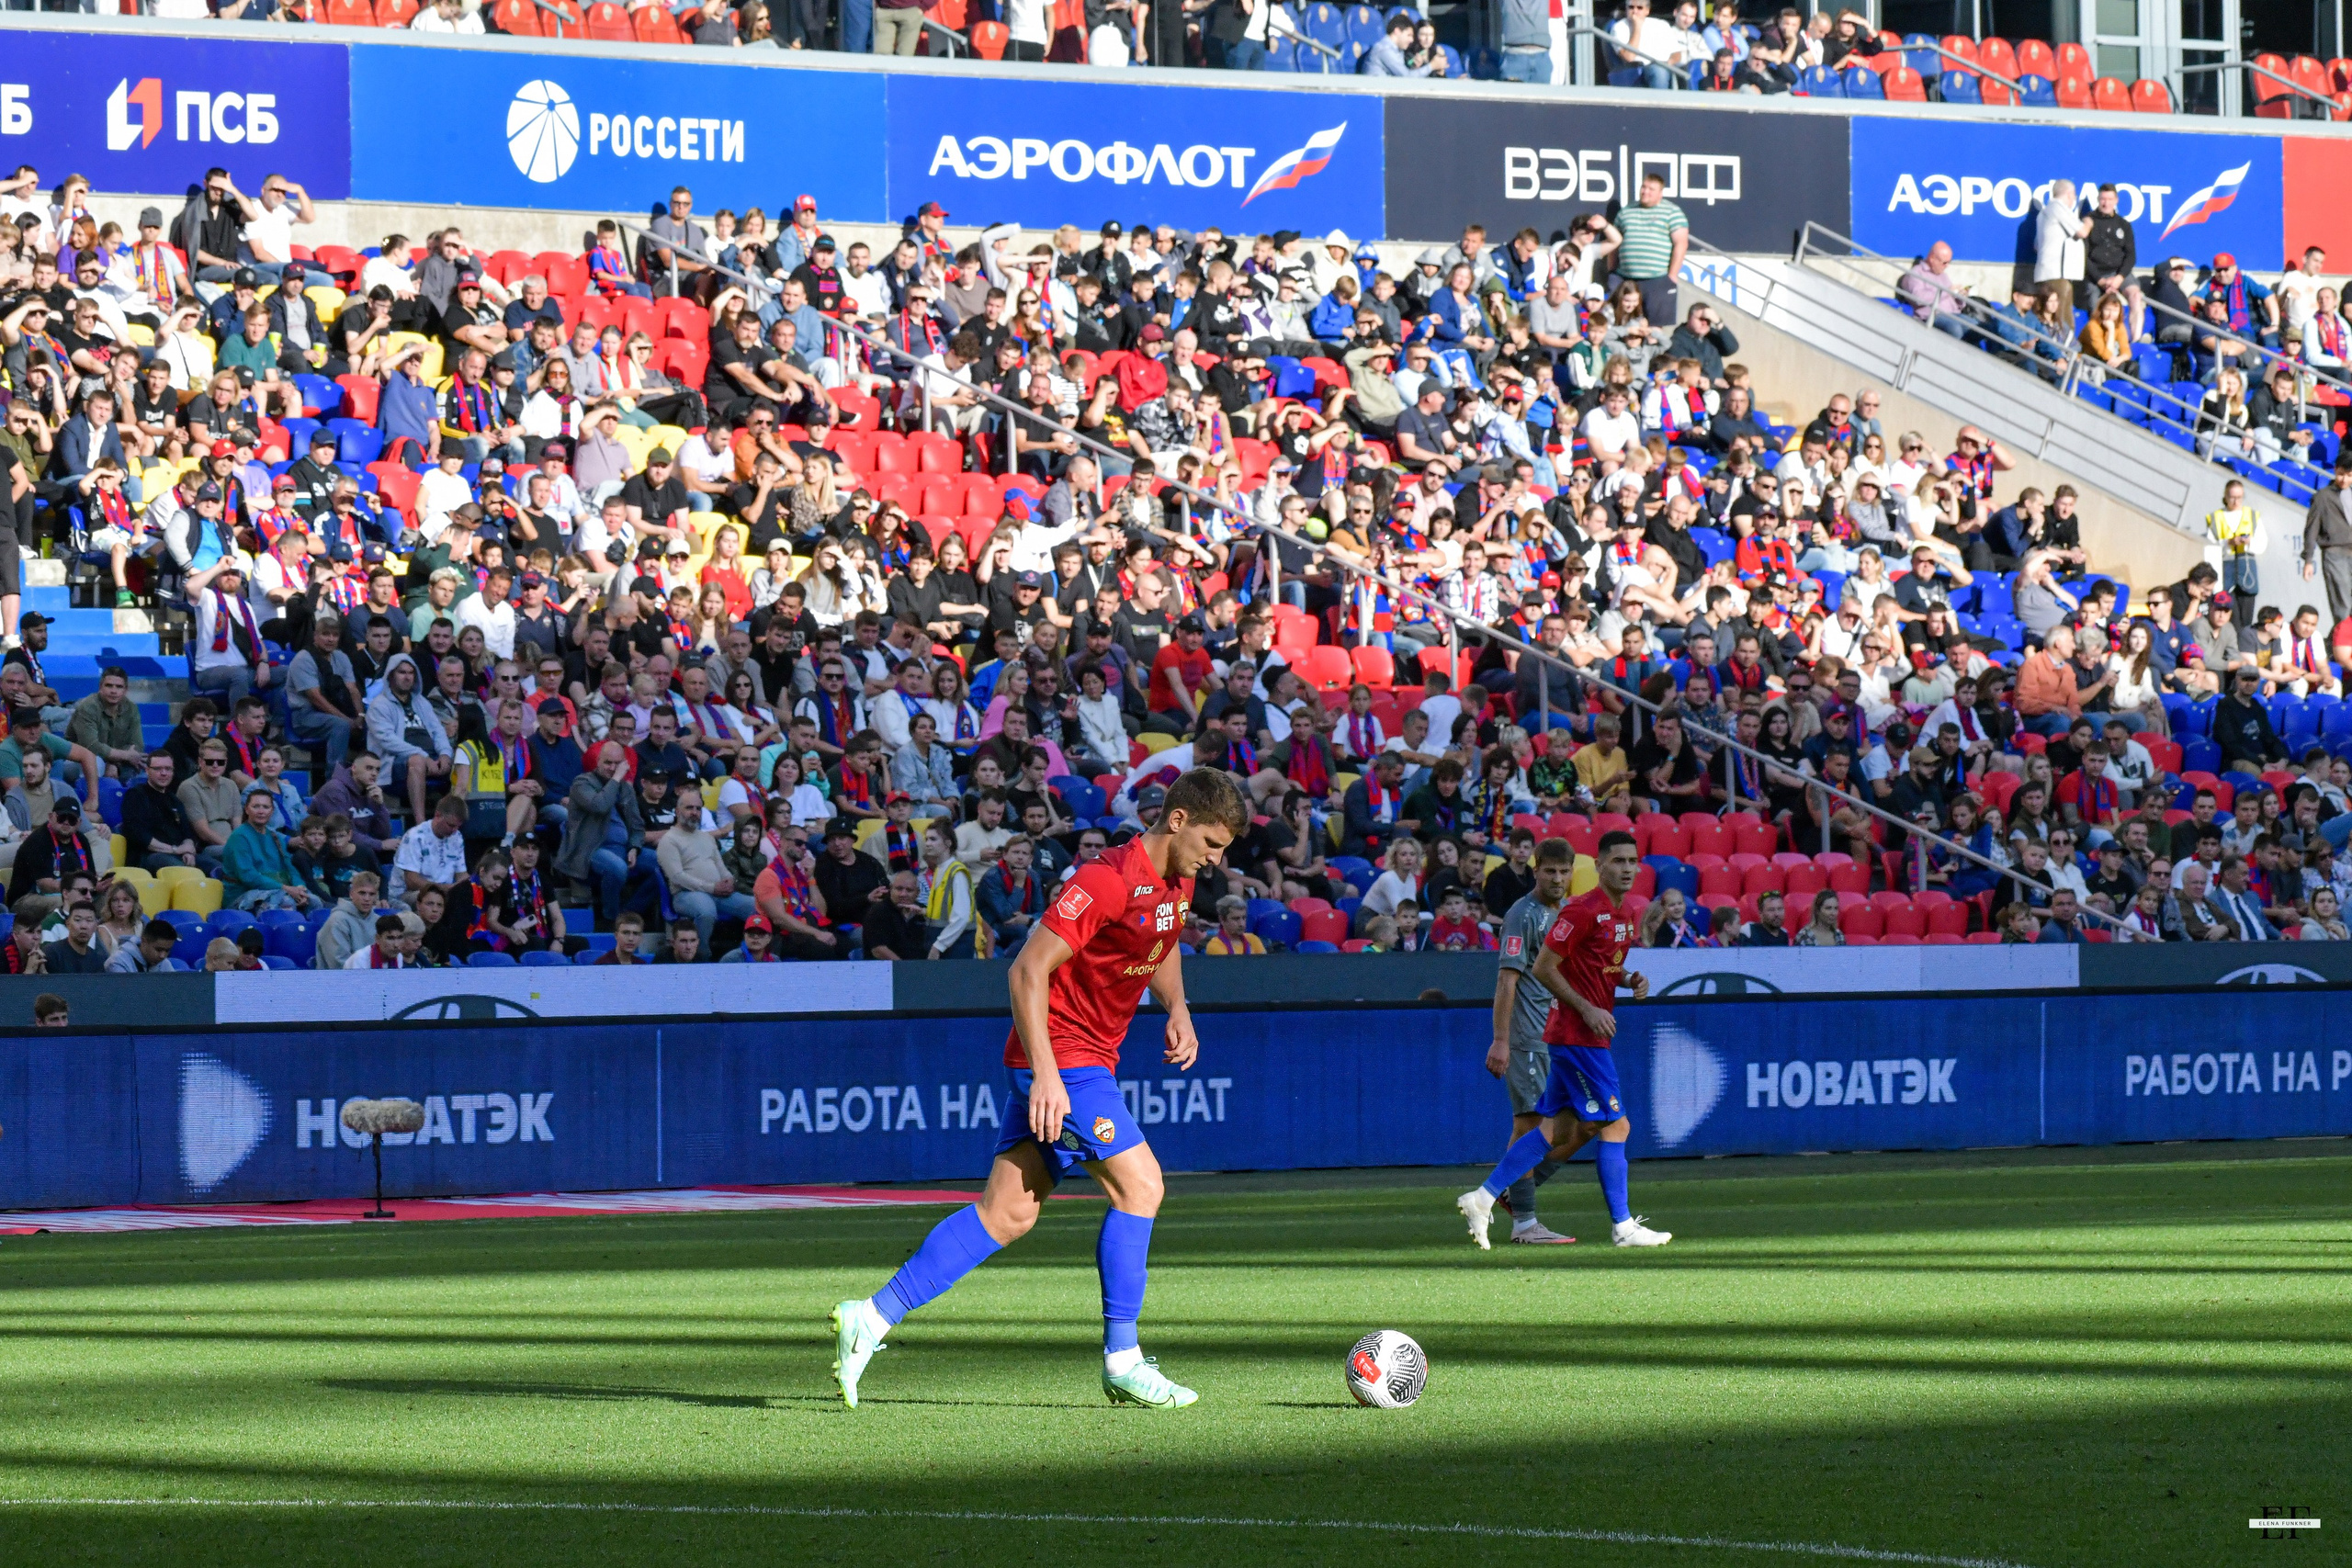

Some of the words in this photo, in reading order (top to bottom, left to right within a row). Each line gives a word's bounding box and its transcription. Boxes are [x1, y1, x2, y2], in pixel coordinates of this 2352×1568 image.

[176, 90, 279, 144] ПСБ
[590, 112, 745, 164] РОССЕТИ
[929, 135, 1256, 188] АЭРОФЛОТ
[1156, 902, 1174, 918] FON
[1157, 916, 1175, 932] BET
[1747, 1057, 1959, 1109] НОВАТЭК
[2125, 1052, 2262, 1097] РАБОТА
[2273, 1051, 2321, 1092] НА
[296, 1093, 555, 1148] НАТЭК
[761, 1085, 926, 1134] РАБОТА
[940, 1083, 1001, 1130] НА
